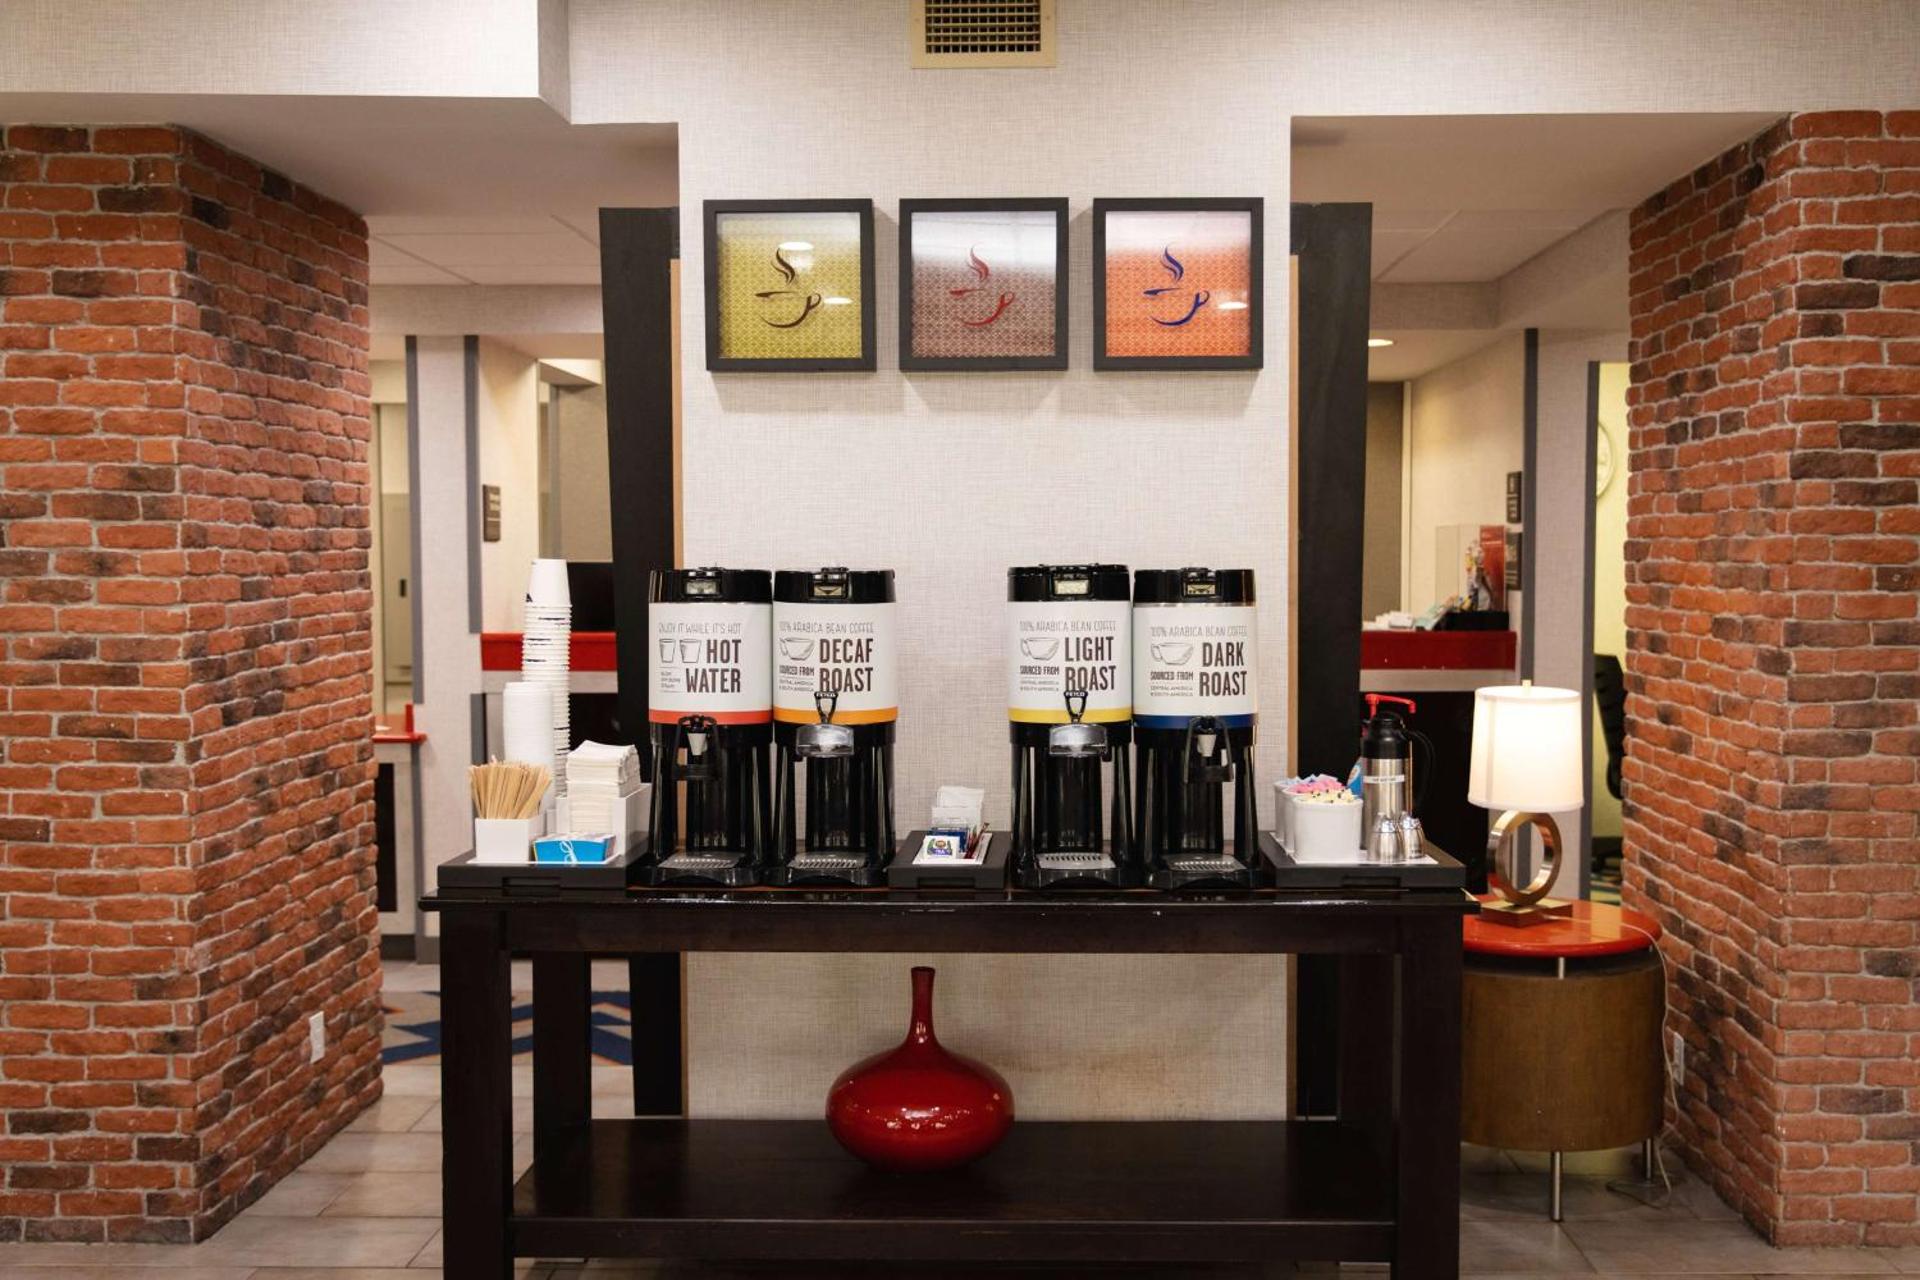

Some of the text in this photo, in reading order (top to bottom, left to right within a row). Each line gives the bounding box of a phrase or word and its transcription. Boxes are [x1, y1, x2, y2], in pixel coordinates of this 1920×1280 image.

[678, 622, 685, 633] IT
[793, 621, 823, 633] ARABICA
[826, 622, 847, 634] BEAN
[849, 622, 874, 634] COFFEE
[1036, 620, 1069, 632] ARABICA
[1071, 620, 1092, 632] BEAN
[1094, 620, 1116, 632] COFFEE
[1169, 625, 1203, 637] ARABICA
[1205, 625, 1226, 637] BEAN
[706, 638, 742, 664] HOT
[820, 638, 874, 664] DECAF
[1064, 636, 1114, 662] LIGHT
[1202, 642, 1244, 667] DARK
[685, 668, 741, 693] WATER
[800, 666, 815, 677] FROM
[819, 667, 874, 693] ROAST
[1020, 665, 1060, 676] SOURCED FROM
[1065, 666, 1117, 692] ROAST
[1150, 671, 1194, 681] SOURCED FROM
[1199, 671, 1247, 697] ROAST
